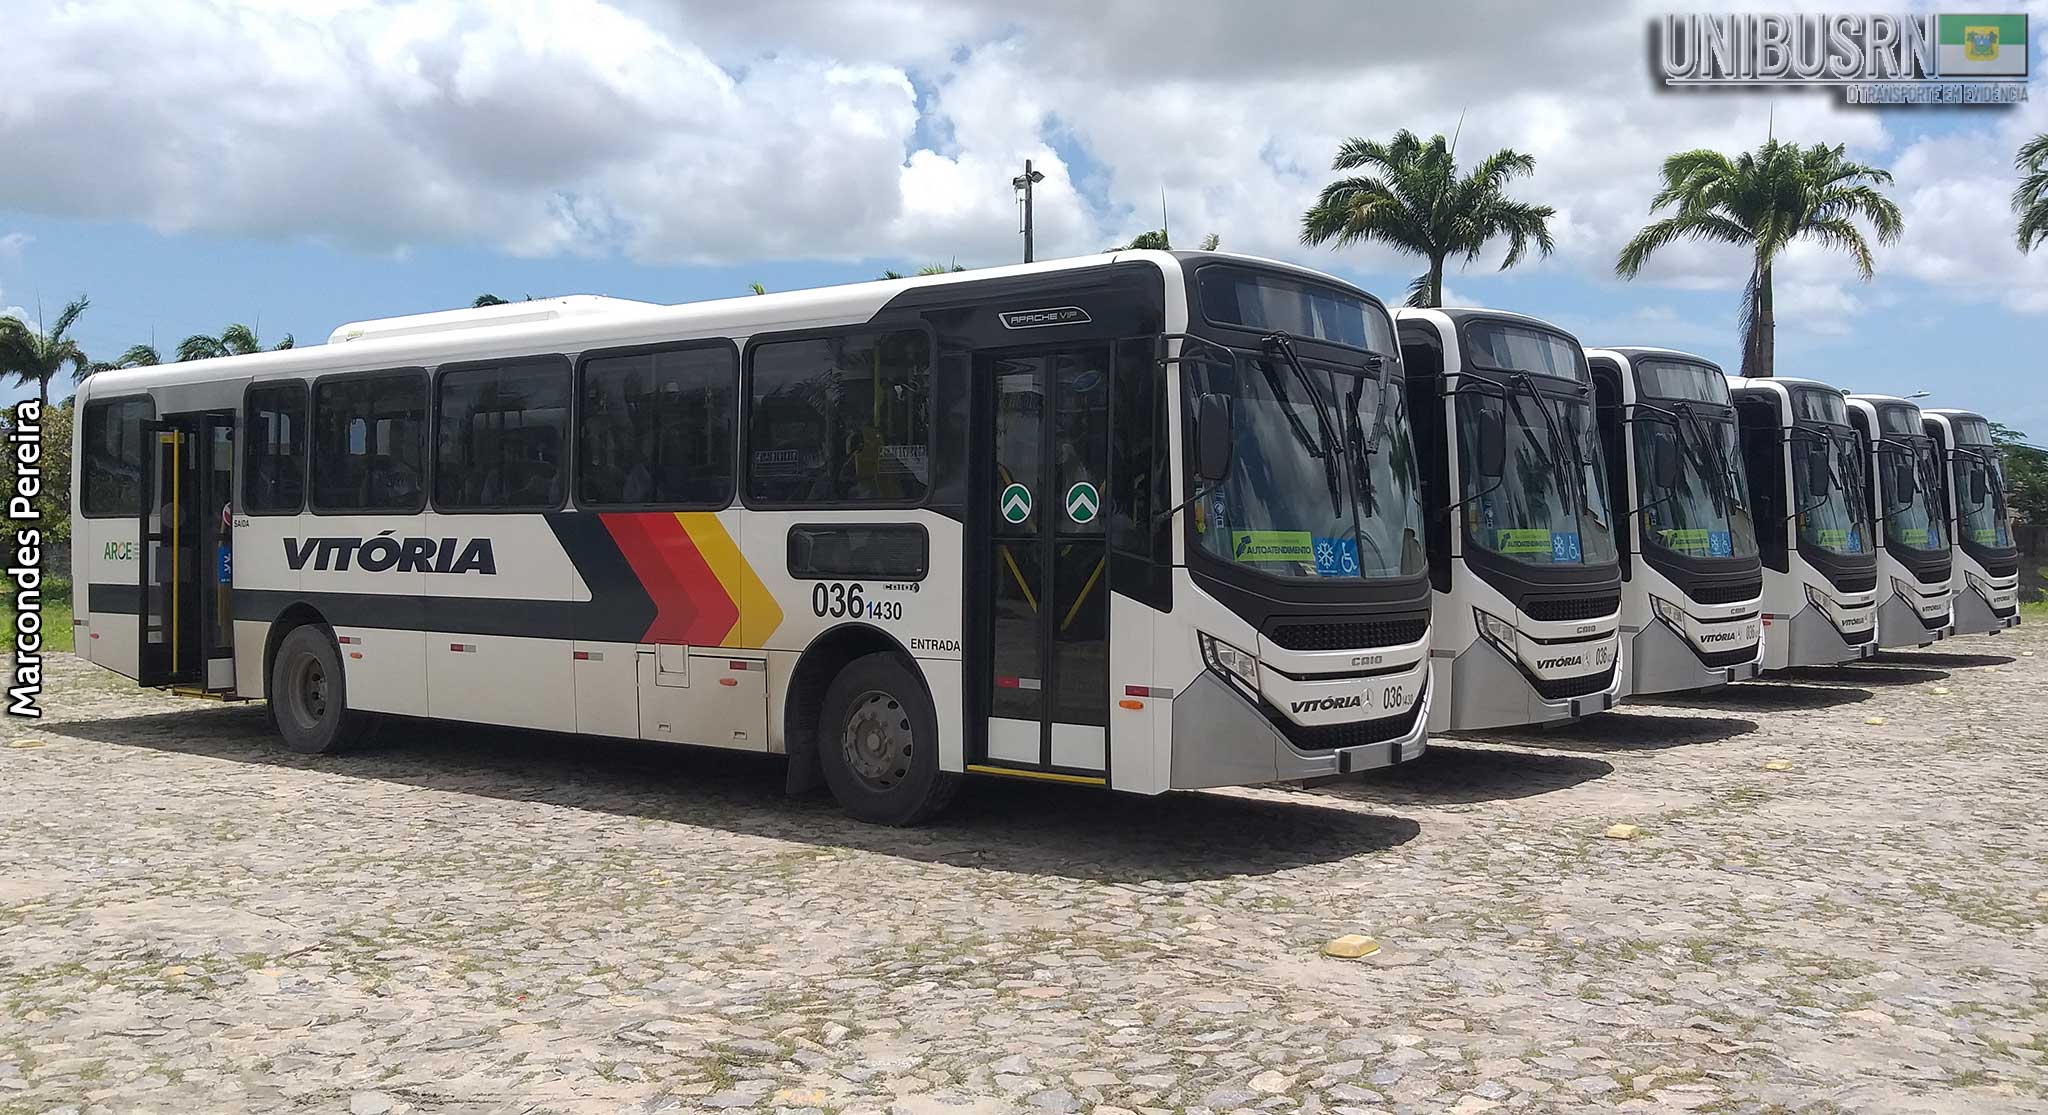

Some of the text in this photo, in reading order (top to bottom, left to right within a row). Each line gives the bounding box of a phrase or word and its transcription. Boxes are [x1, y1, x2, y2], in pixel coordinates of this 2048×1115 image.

[1010, 311, 1077, 324] APACHE VIP
[104, 542, 132, 560] ARCE
[283, 530, 497, 575] VITÓRIA
[1247, 546, 1311, 554] AUTOATENDIMENTO
[812, 583, 902, 620] 036 1430
[1700, 632, 1736, 642] VITÓRIA
[910, 638, 961, 652] ENTRADA
[1351, 655, 1383, 666] CAIO
[1536, 655, 1583, 669] VITÓRIA
[1290, 695, 1361, 713] VITÓRIA
[1383, 685, 1403, 709] 036
